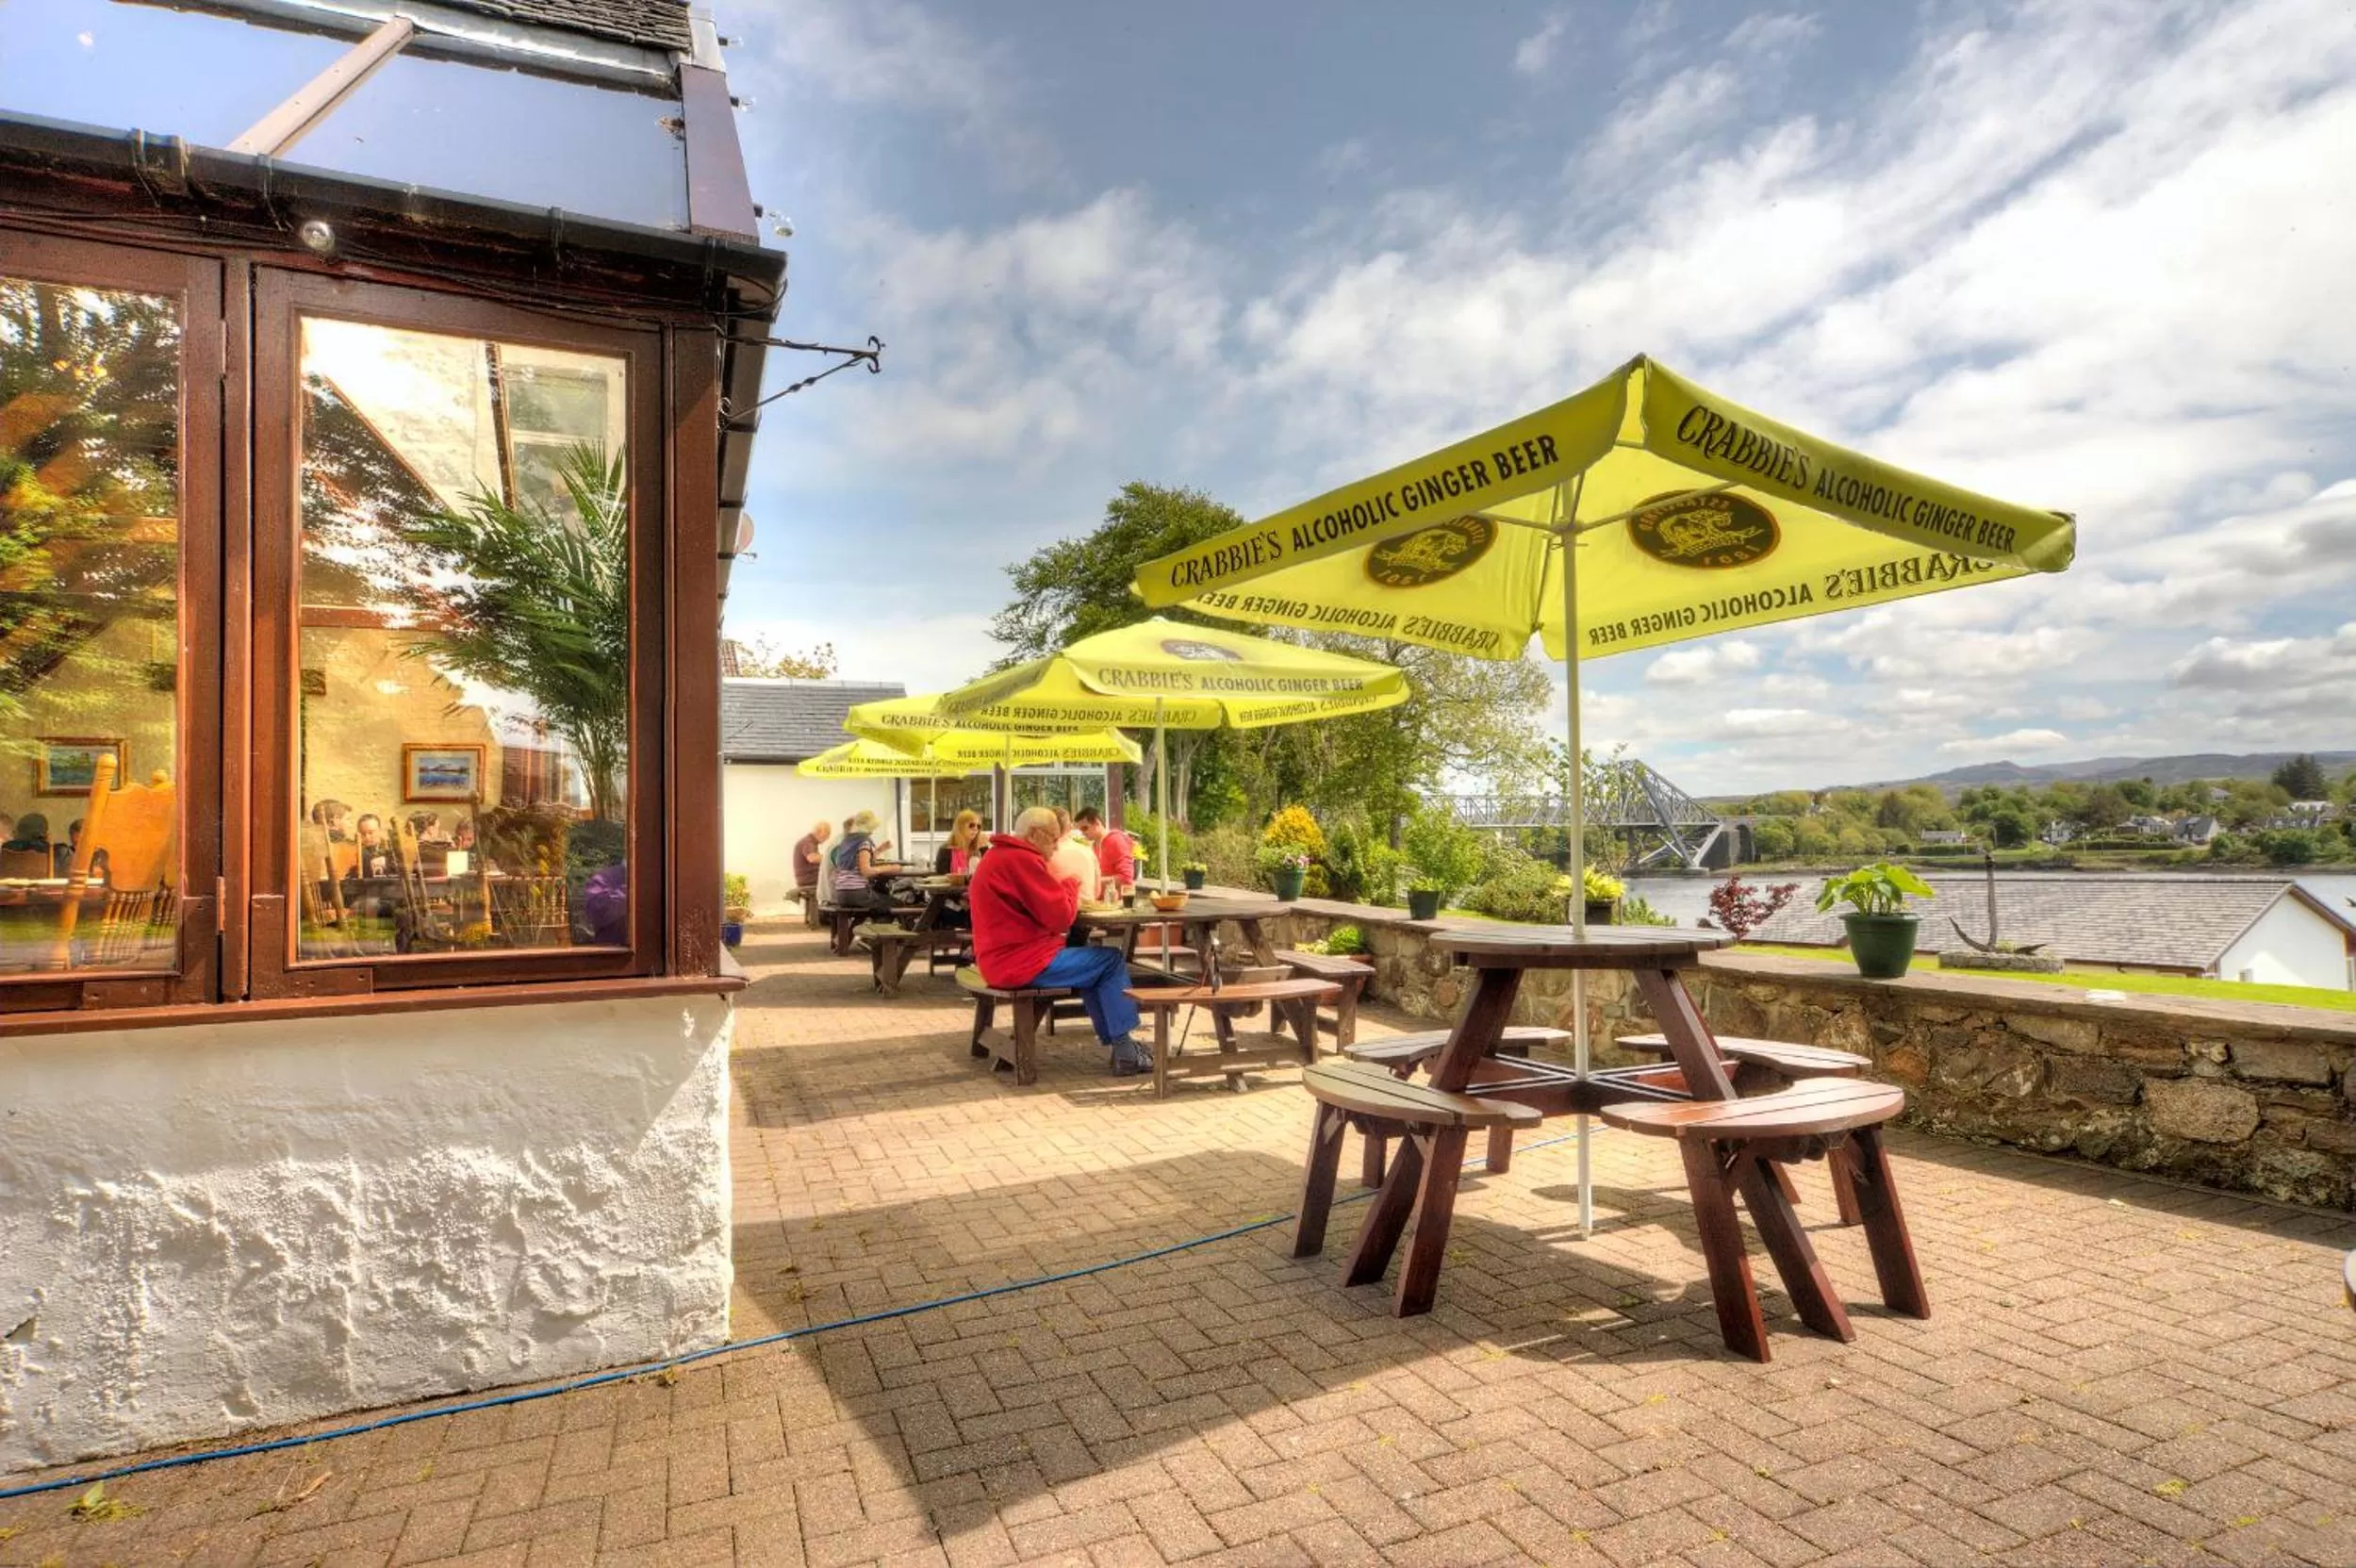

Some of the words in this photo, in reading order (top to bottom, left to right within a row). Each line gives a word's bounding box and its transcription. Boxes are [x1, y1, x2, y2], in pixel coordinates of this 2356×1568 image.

[1170, 531, 1282, 588] CRABBIE'S
[1293, 491, 1400, 553] ALCOHOLIC
[1401, 470, 1491, 512] GINGER
[1493, 434, 1559, 481] BEER
[1676, 404, 1811, 489] CRABBIE'S
[1814, 471, 1914, 524] ALCOHOLIC
[1914, 501, 1975, 542] GINGER
[1976, 519, 2016, 553] BEER
[1098, 668, 1193, 690] CRABBIE'S
[1200, 676, 1275, 691] ALCOHOLIC
[1277, 678, 1328, 692] GINGER
[1332, 678, 1363, 691] BEER
